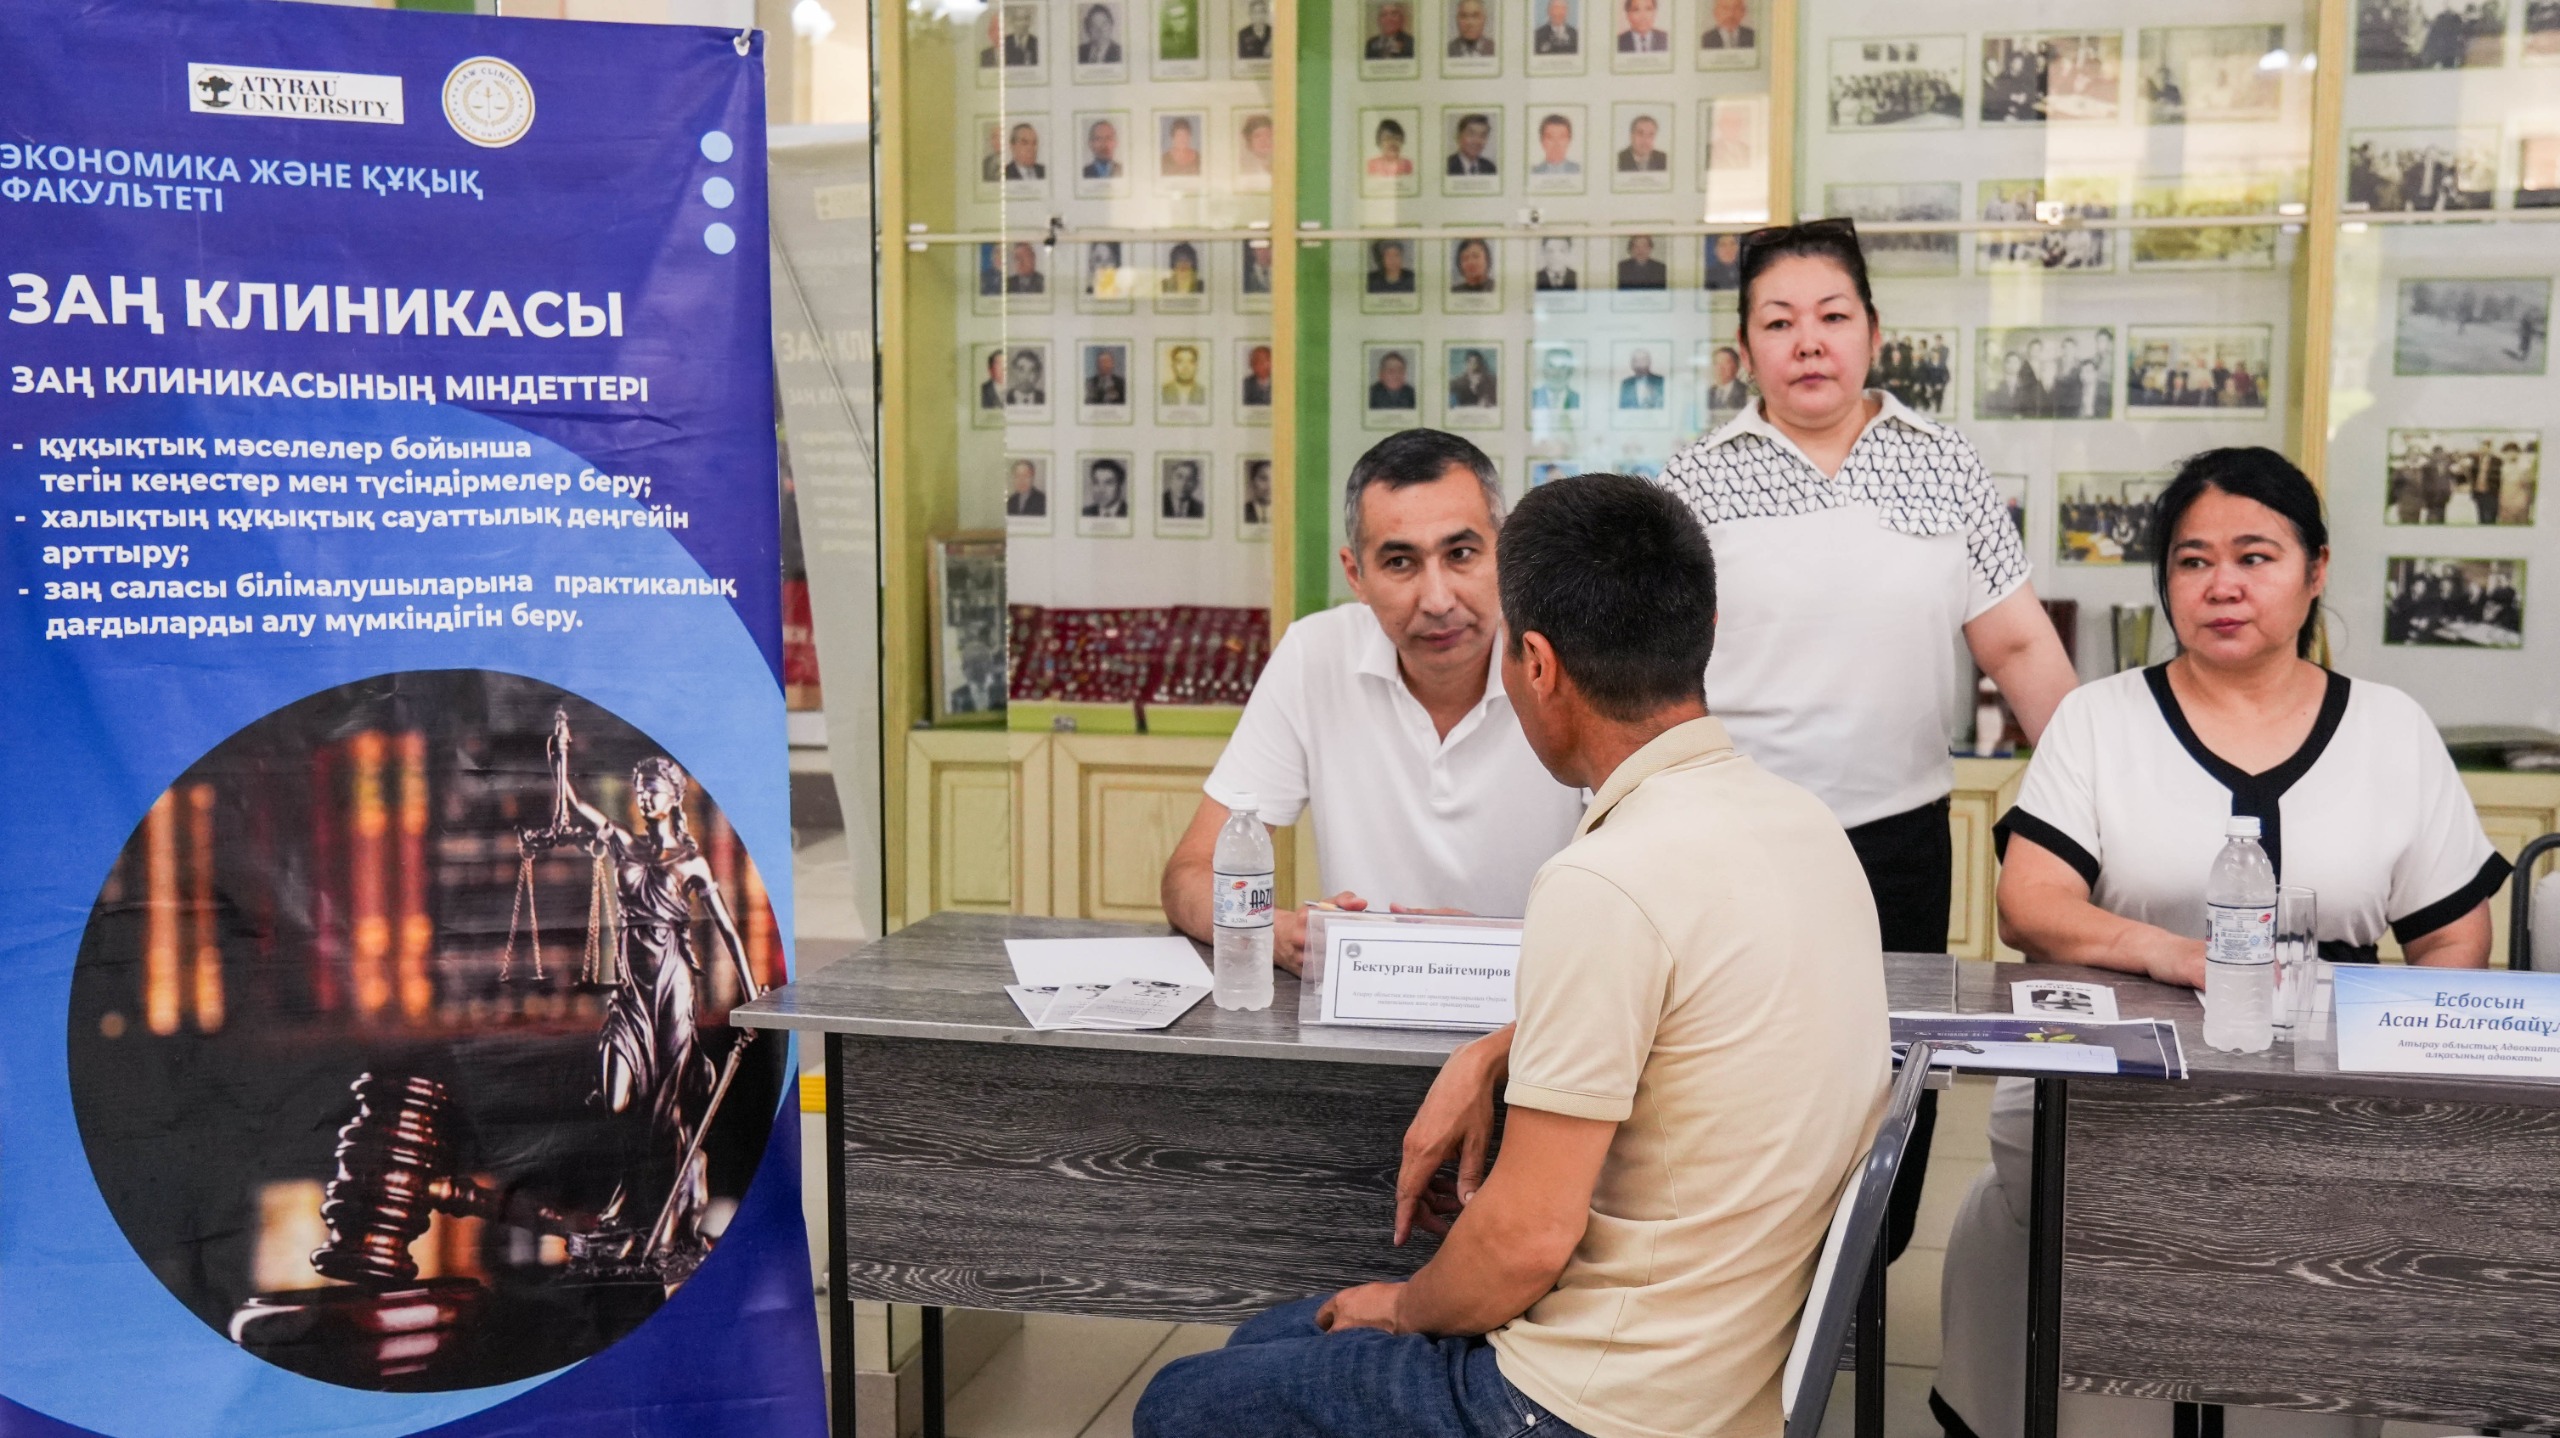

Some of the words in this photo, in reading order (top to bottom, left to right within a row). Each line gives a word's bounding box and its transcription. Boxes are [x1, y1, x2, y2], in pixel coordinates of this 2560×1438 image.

[240, 76, 337, 97] ATYRAU
[457, 69, 476, 85] LAW
[481, 67, 516, 85] CLINIC
[241, 94, 389, 117] UNIVERSITY
[0, 143, 241, 183] ЭКОНОМИКА
[250, 159, 351, 189] ЖӘНЕ
[362, 165, 483, 200] ҚҰҚЫҚ
[1, 176, 223, 212] ФАКУЛЬТЕТІ
[8, 272, 164, 334] ЗАҢ
[185, 279, 624, 338] КЛИНИКАСЫ
[12, 366, 95, 398] ЗАҢ
[105, 367, 436, 405] КЛИНИКАСЫНЫҢ
[446, 376, 648, 404] МІНДЕТТЕРІ
[40, 438, 207, 462] құқықтық
[214, 438, 383, 465] мәселелер
[391, 436, 531, 460] бойынша
[40, 466, 122, 492] тегін
[132, 473, 280, 497] кеңестер
[289, 474, 347, 493] мен
[356, 468, 571, 499] түсіндірмелер
[579, 468, 651, 499] беру;
[41, 509, 209, 530] халықтың
[218, 508, 375, 532] құқықтық
[382, 507, 561, 533] сауаттылық
[567, 504, 689, 529] деңгейін
[42, 545, 189, 570] арттыру;
[44, 581, 102, 602] заң
[110, 580, 227, 598] саласы
[236, 571, 533, 602] білімалушыларына
[555, 575, 737, 598] практикалық
[46, 615, 253, 640] дағдыларды
[262, 613, 316, 637] алу
[325, 604, 503, 636] мүмкіндігін
[511, 603, 583, 632] беру.
[1353, 960, 1423, 976] Бектурган
[1428, 962, 1511, 979] Байтемиров
[2434, 991, 2525, 1010] Есбосын
[2378, 1012, 2429, 1028] Асан
[2398, 1039, 2440, 1050] Атырау
[2442, 1042, 2498, 1052] облыстық
[2425, 1051, 2485, 1062] алқасының
[2487, 1053, 2543, 1063] адвокаты
